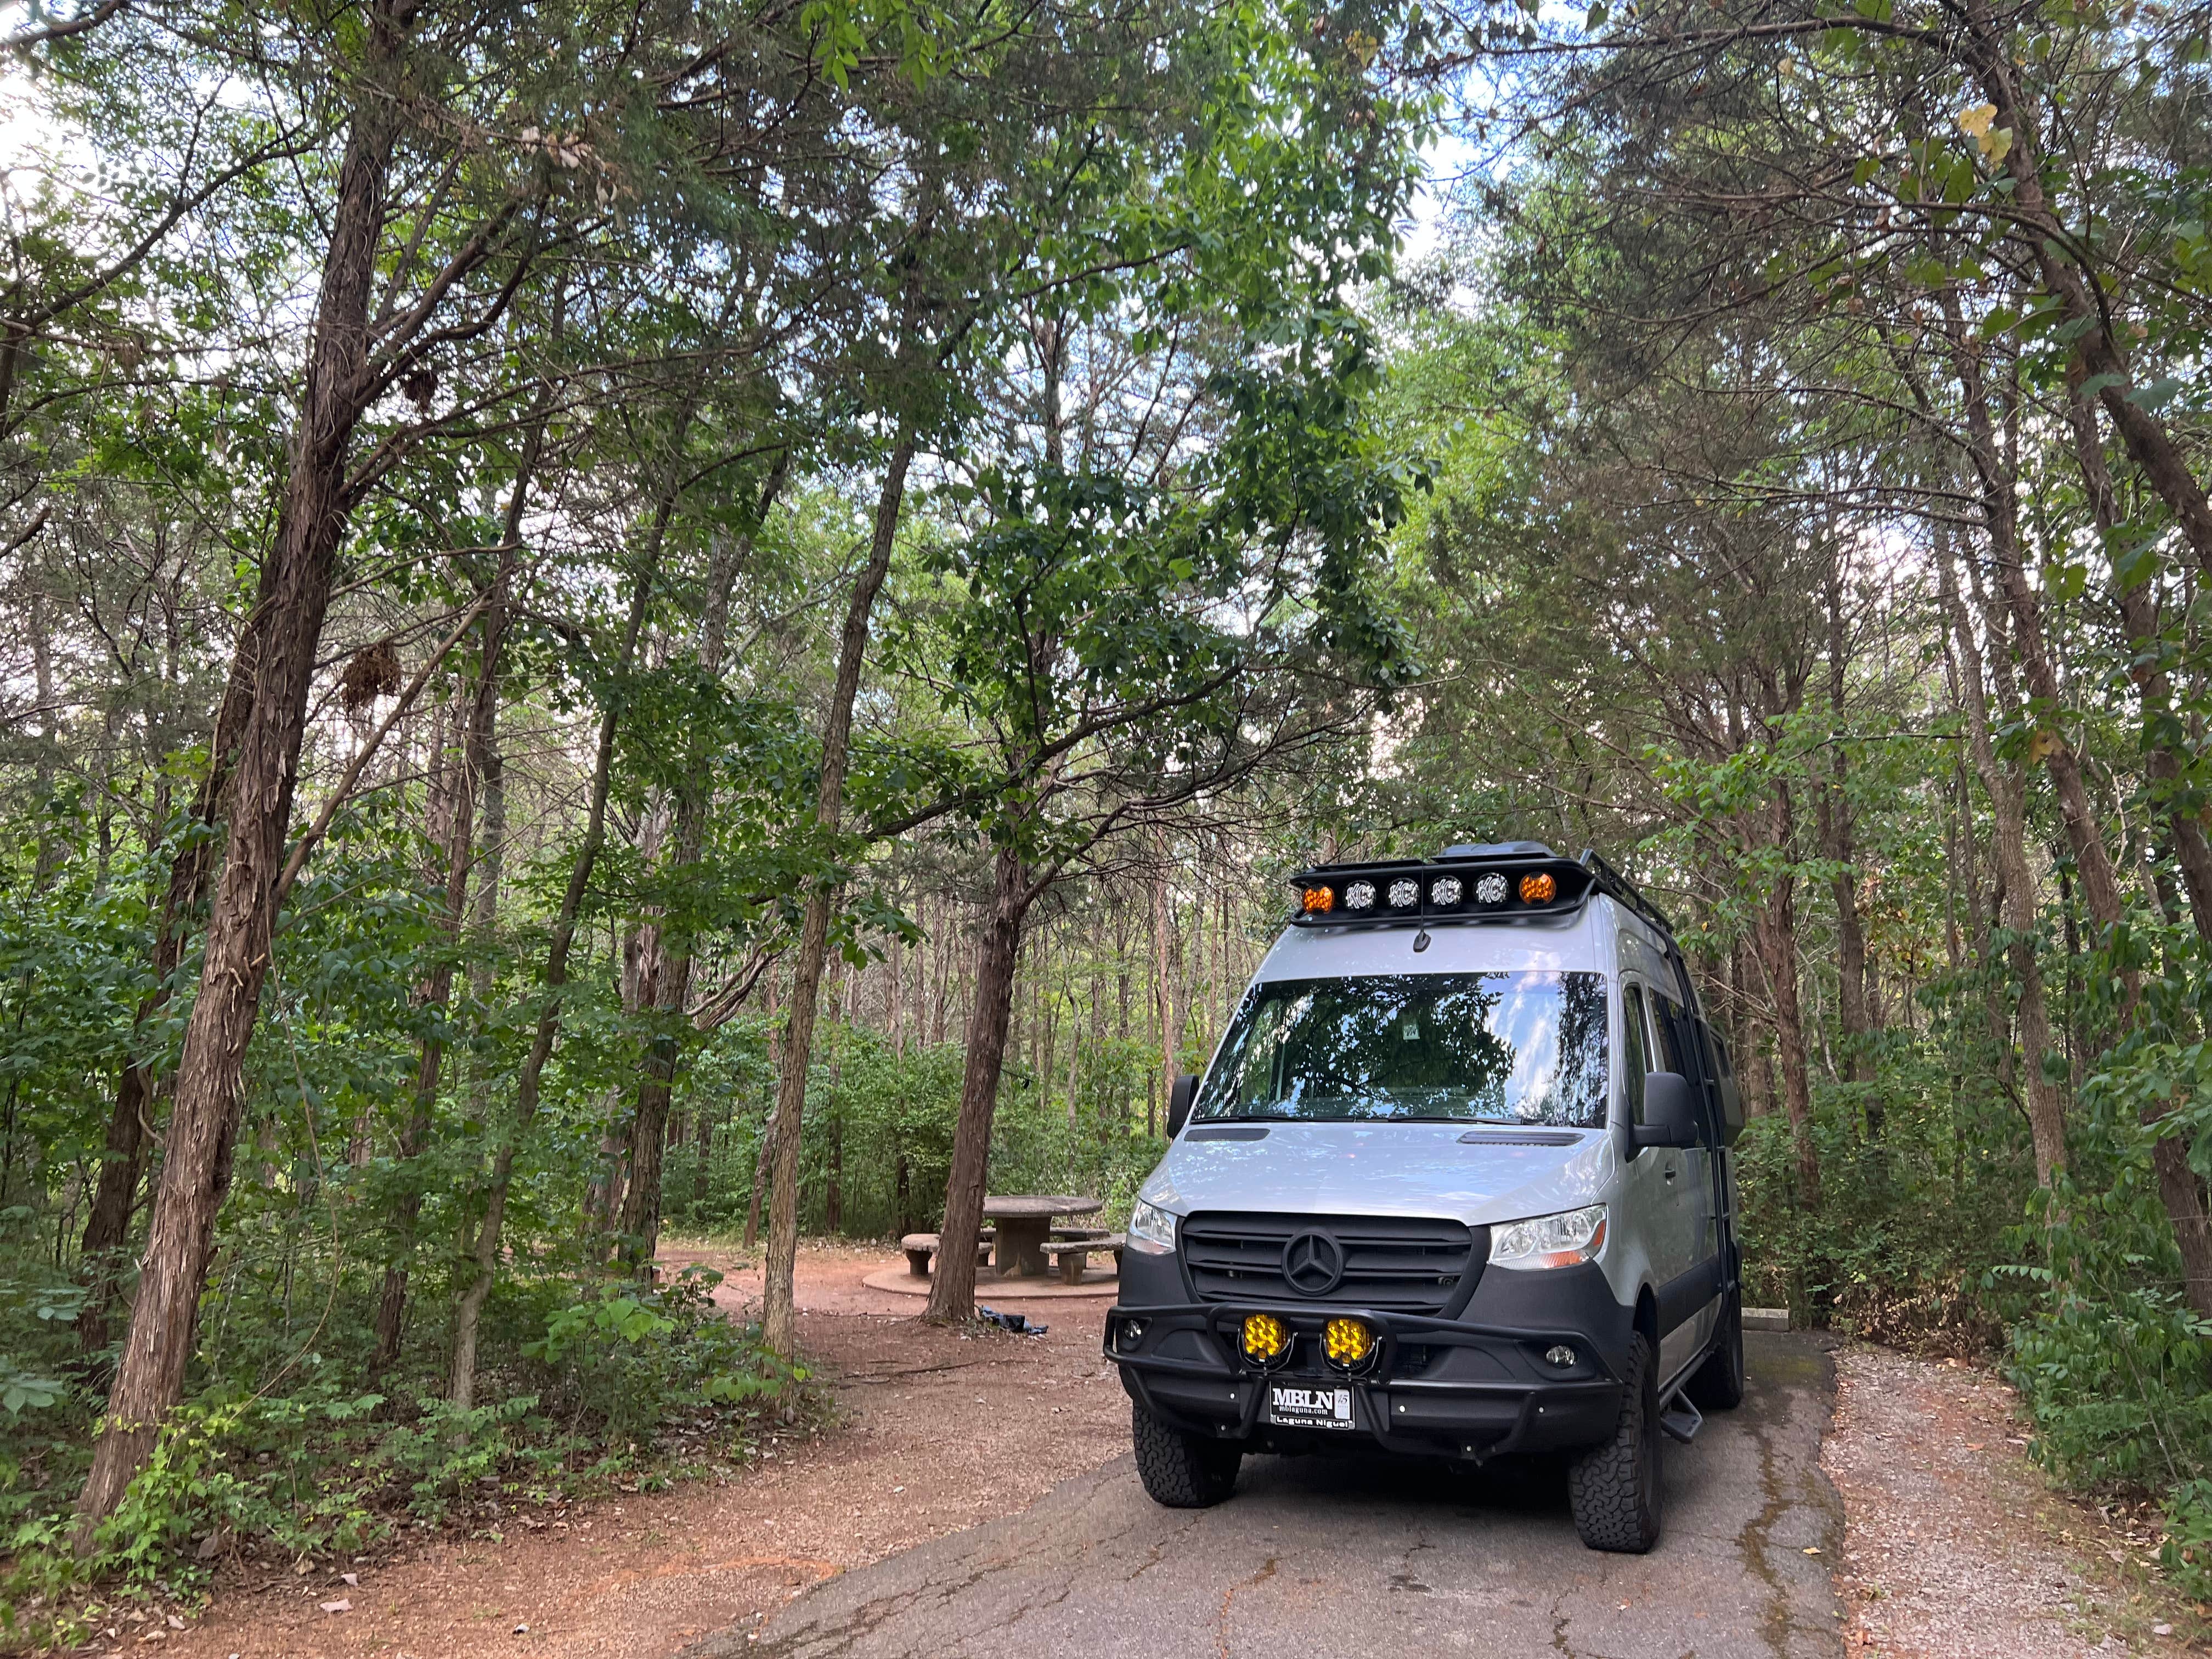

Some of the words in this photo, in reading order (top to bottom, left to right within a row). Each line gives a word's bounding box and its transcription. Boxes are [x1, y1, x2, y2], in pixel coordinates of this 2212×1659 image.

[1347, 883, 1368, 909] KC
[1390, 881, 1412, 907] KC
[1433, 879, 1454, 905] KC
[1478, 877, 1502, 903] KC
[1272, 1388, 1334, 1410] MBLN
[1279, 1405, 1328, 1415] mblaguna.com
[1277, 1416, 1313, 1425] Laguna
[1316, 1419, 1348, 1428] Niguel
